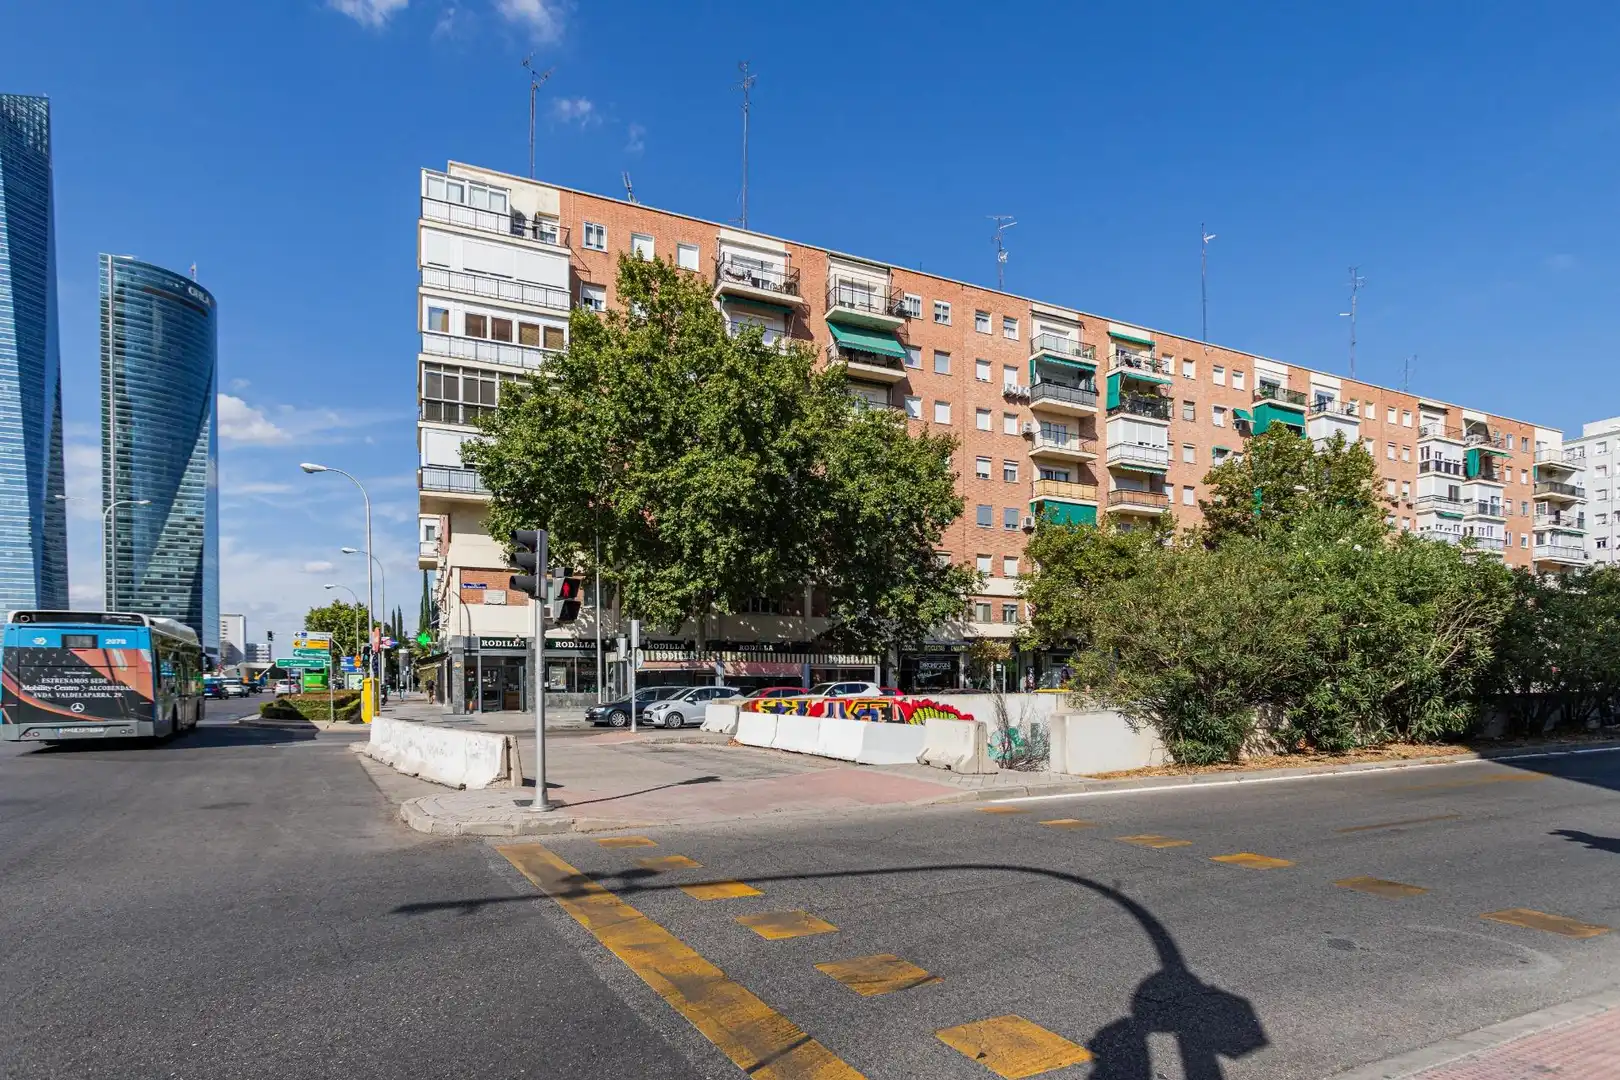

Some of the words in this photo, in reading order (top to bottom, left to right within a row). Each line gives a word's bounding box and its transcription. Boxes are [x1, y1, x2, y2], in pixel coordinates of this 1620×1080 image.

[481, 639, 525, 647] RODILLA
[555, 641, 596, 649] RODILLA
[656, 652, 695, 660] RODILLA
